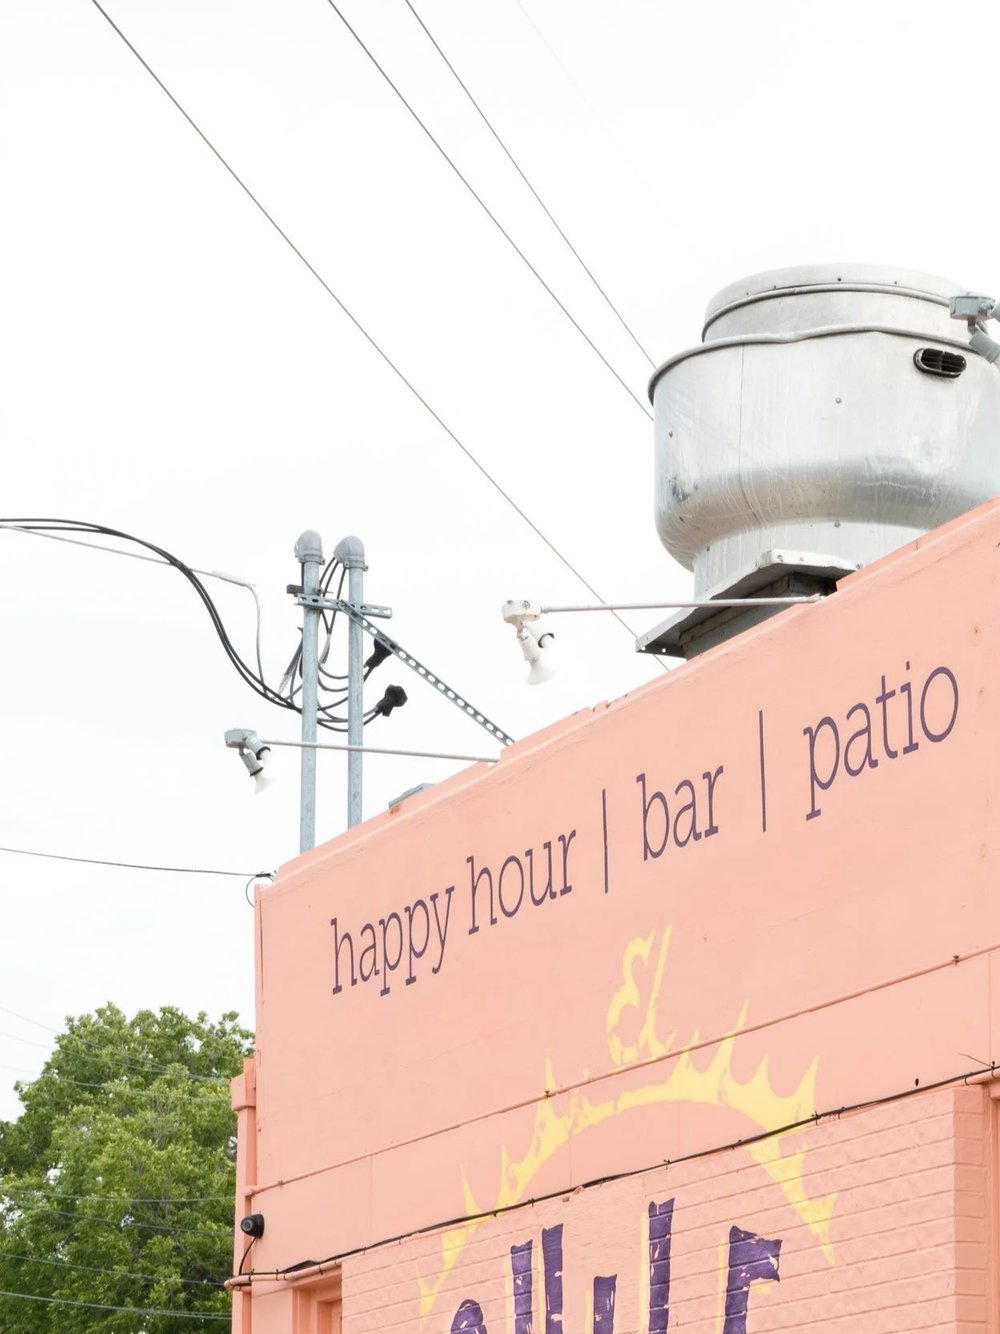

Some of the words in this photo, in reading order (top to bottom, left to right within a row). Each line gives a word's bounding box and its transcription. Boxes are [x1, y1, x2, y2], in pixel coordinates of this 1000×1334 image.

[330, 886, 455, 997] happy
[466, 829, 577, 935] hour
[636, 765, 724, 862] bar
[803, 660, 959, 821] patio
